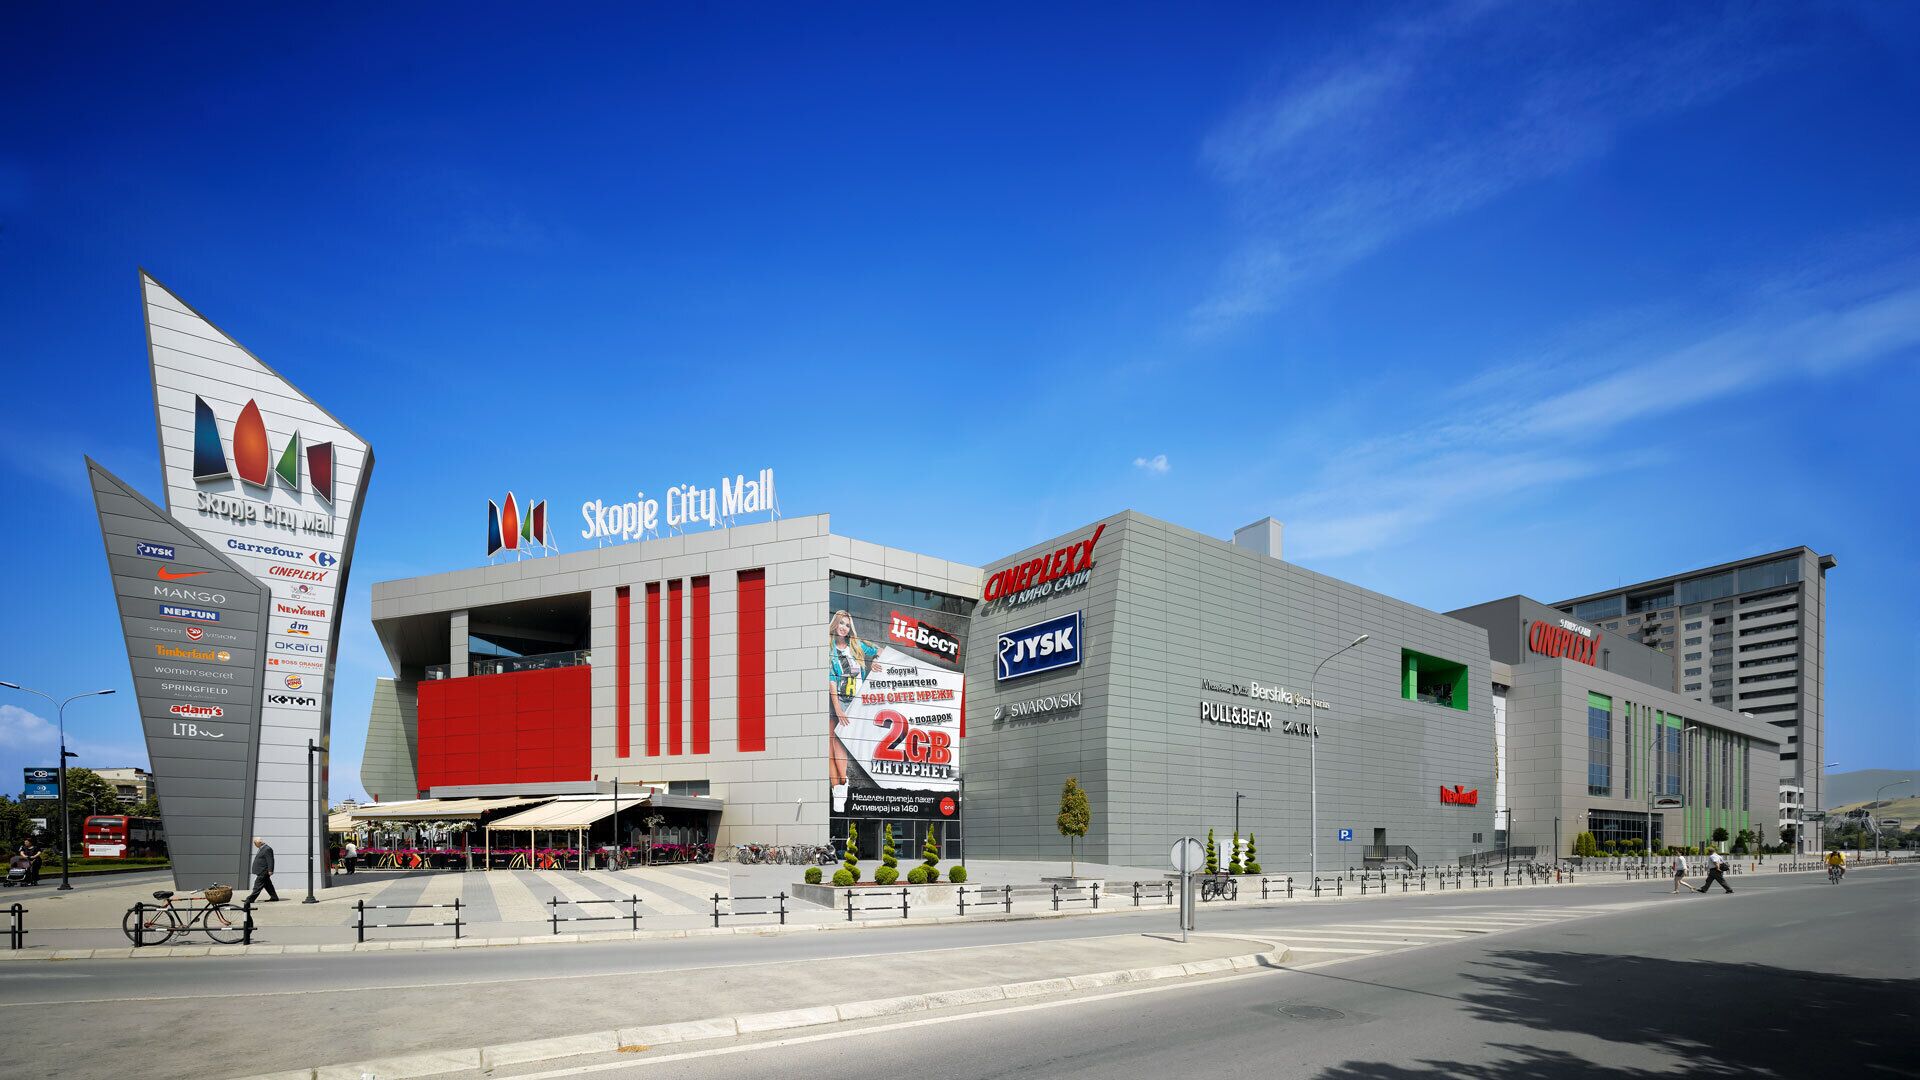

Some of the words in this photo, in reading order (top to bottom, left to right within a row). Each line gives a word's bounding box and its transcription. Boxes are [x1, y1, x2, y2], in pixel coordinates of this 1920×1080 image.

[581, 492, 658, 540] Skopje
[666, 483, 715, 528] City
[722, 468, 774, 517] Mall
[197, 492, 256, 521] Skopje
[263, 503, 297, 531] City
[302, 514, 334, 535] Mall
[144, 545, 173, 557] JYSK
[227, 539, 303, 559] Carrefour
[984, 524, 1106, 603] CINEPLEXX
[269, 566, 328, 581] CINEPLEXX
[154, 586, 226, 604] MANGO
[1008, 595, 1016, 607] 9
[1018, 583, 1052, 604] КИНО
[1055, 569, 1092, 592] САЛИ
[163, 606, 216, 620] NEPTUN
[149, 626, 182, 634] SPORT
[205, 632, 236, 640] VISION
[290, 621, 308, 630] dm
[1013, 626, 1074, 663] JYSK
[1529, 620, 1603, 667] CINEPLEXX
[155, 644, 215, 661] Timberland
[155, 666, 234, 679] women'secret
[886, 665, 918, 677] зборувај
[161, 683, 228, 695] SPRINGFIELD
[869, 678, 937, 690] неограничено
[861, 693, 884, 705] КОН
[887, 691, 914, 703] СИТЕ
[916, 689, 954, 701] МРЕЖИ
[1251, 681, 1293, 704] Bershka
[171, 704, 223, 716] adam's
[1011, 691, 1082, 718] SWAROVSKI
[915, 713, 952, 725] подарок
[1201, 701, 1272, 729] PULL&BEAR
[173, 722, 198, 737] LTB
[873, 709, 952, 764] 2GB
[871, 760, 950, 778] ИНТЕРНЕТ
[852, 792, 885, 802] Неделен
[885, 795, 914, 804] припејд
[851, 803, 890, 813] Активирај
[901, 804, 919, 813] 1460
